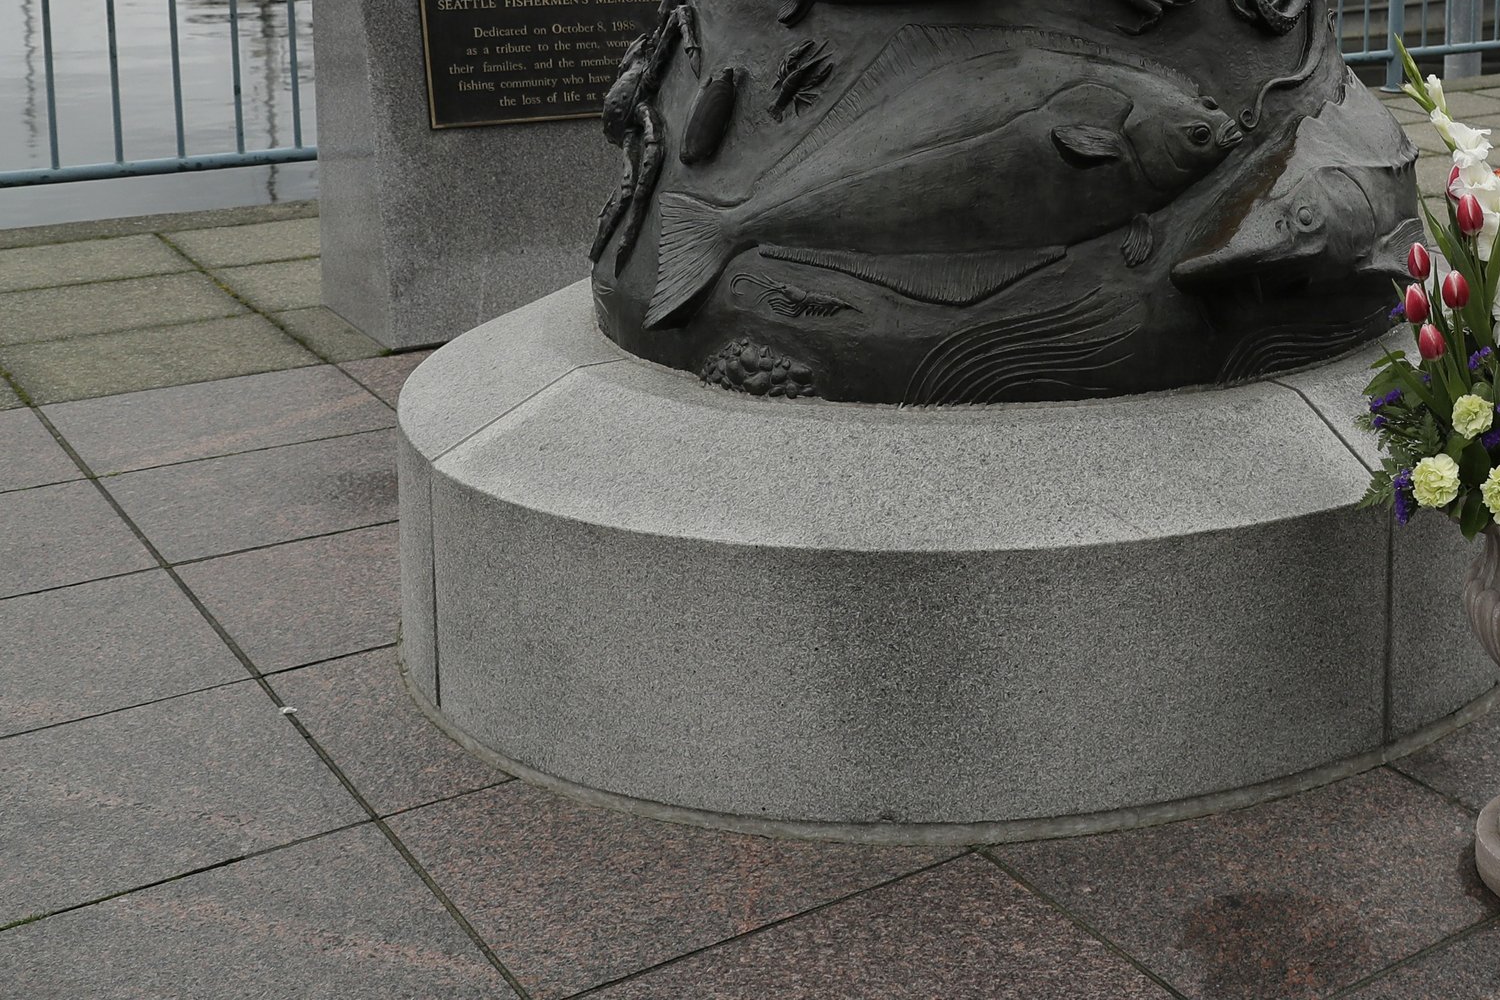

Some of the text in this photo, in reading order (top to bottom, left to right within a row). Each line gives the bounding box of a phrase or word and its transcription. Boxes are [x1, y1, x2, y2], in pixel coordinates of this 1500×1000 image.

[473, 25, 528, 38] Dedicated
[533, 27, 547, 36] on
[551, 22, 594, 34] October
[611, 20, 636, 32] 1988
[466, 47, 478, 56] as
[483, 47, 490, 55] a
[496, 42, 531, 54] tribute
[538, 43, 549, 52] to
[554, 40, 571, 51] the
[449, 63, 474, 75] their
[534, 58, 553, 70] and
[558, 57, 575, 68] the
[458, 73, 611, 92] fishing community who have
[499, 96, 517, 107] the
[522, 94, 541, 105] loss
[546, 91, 558, 103] of
[563, 91, 581, 102] life
[586, 92, 597, 101] at
